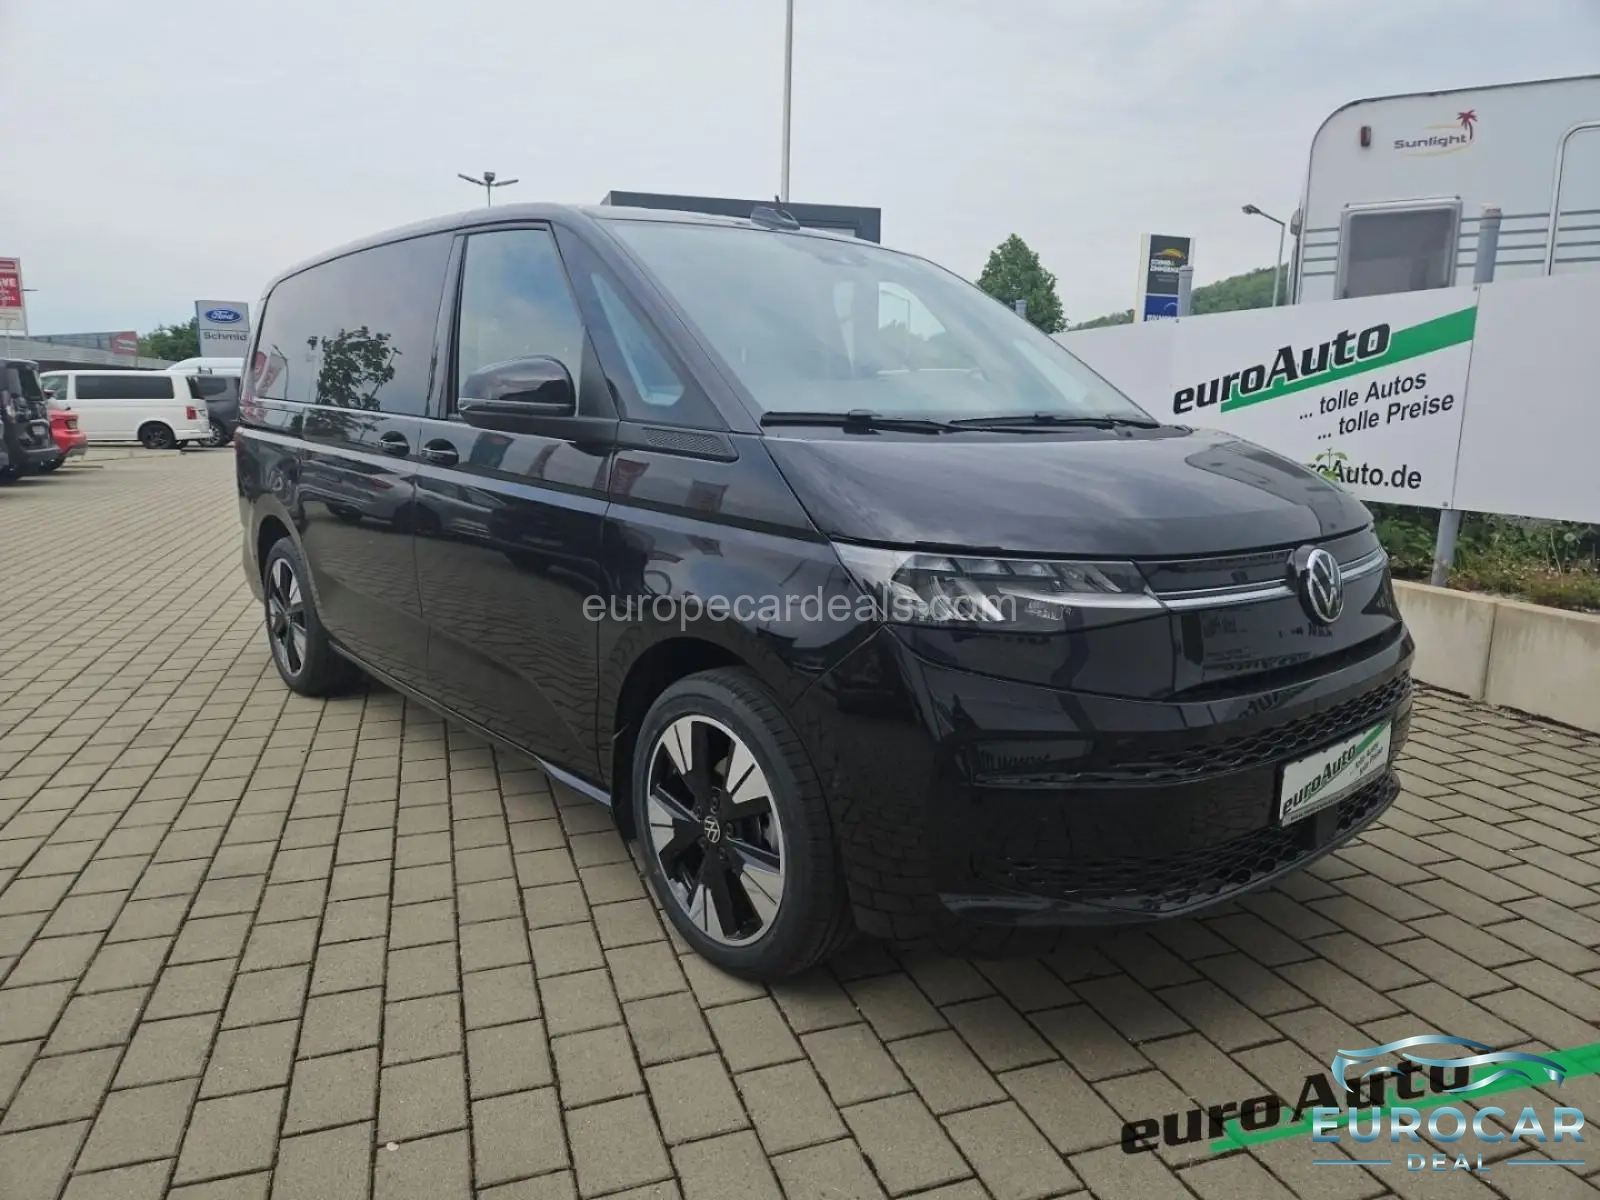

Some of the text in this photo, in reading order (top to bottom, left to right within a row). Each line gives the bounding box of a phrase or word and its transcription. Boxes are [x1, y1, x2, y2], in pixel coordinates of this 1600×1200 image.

[1393, 134, 1467, 150] Sunlight
[203, 331, 248, 341] Schmid
[1173, 323, 1391, 415] euroAuto
[1320, 389, 1359, 415] tolle
[1364, 372, 1427, 403] Autos
[1339, 410, 1380, 435] tolle
[1387, 393, 1454, 424] Preise
[1307, 459, 1422, 489] Auto.de
[1282, 744, 1356, 814] euroAuto
